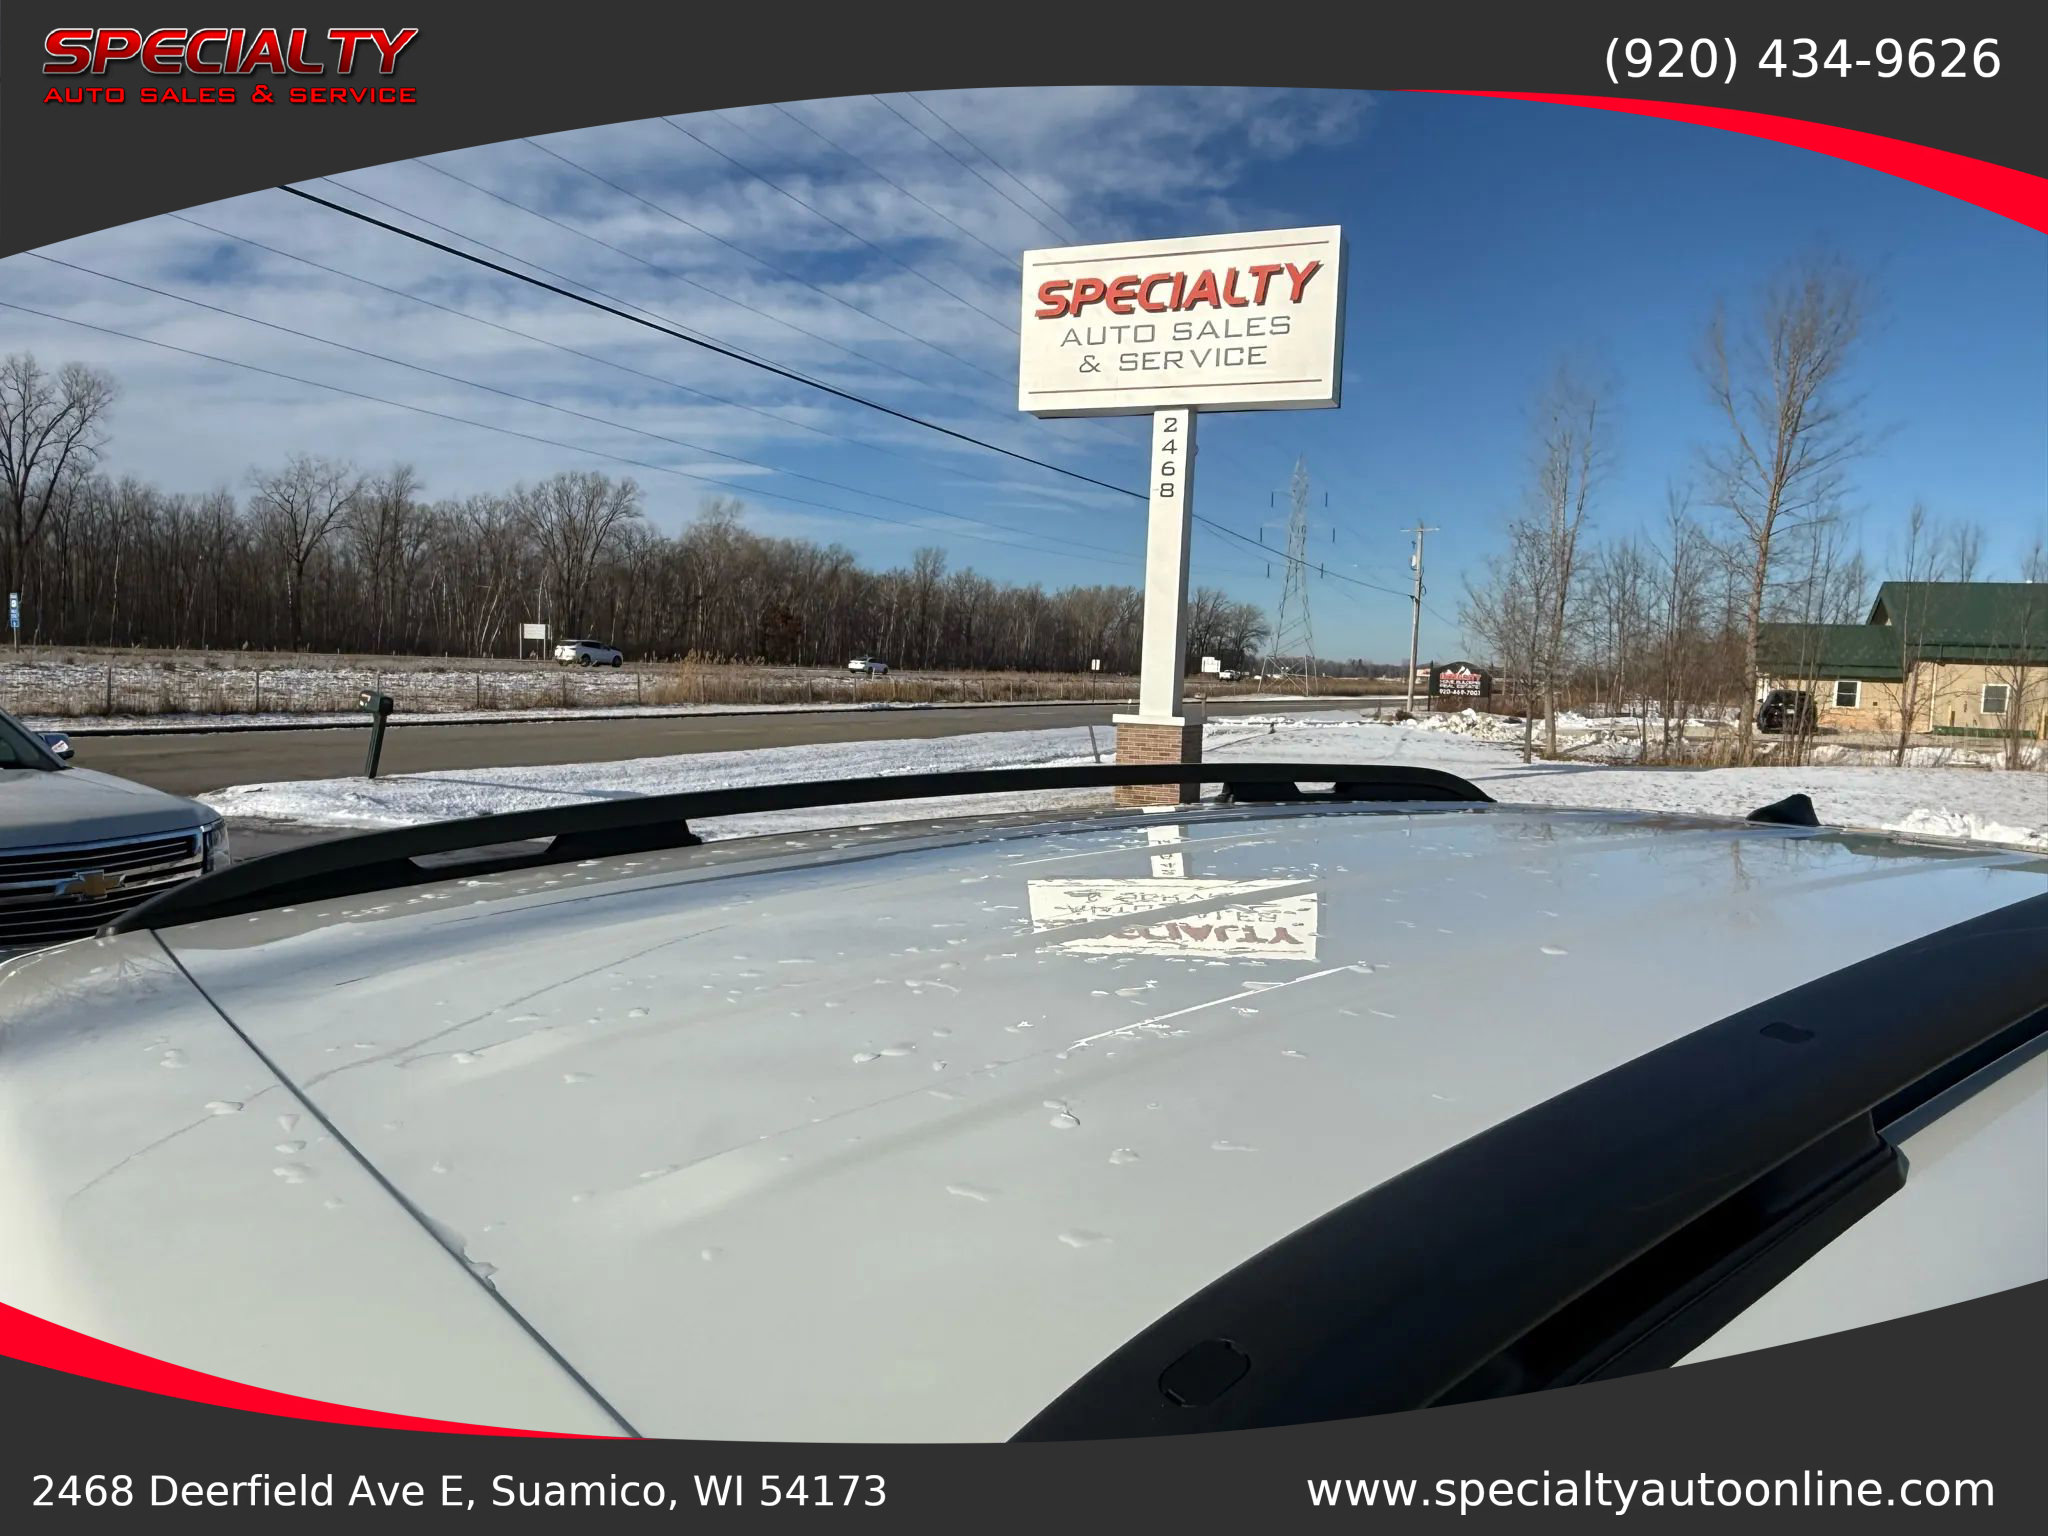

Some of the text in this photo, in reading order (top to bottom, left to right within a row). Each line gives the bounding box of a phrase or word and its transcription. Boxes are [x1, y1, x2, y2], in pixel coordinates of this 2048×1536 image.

[1034, 260, 1322, 319] SPECIALTY
[1060, 315, 1291, 347] AUTO SALES
[1079, 345, 1268, 373] & SERVICE
